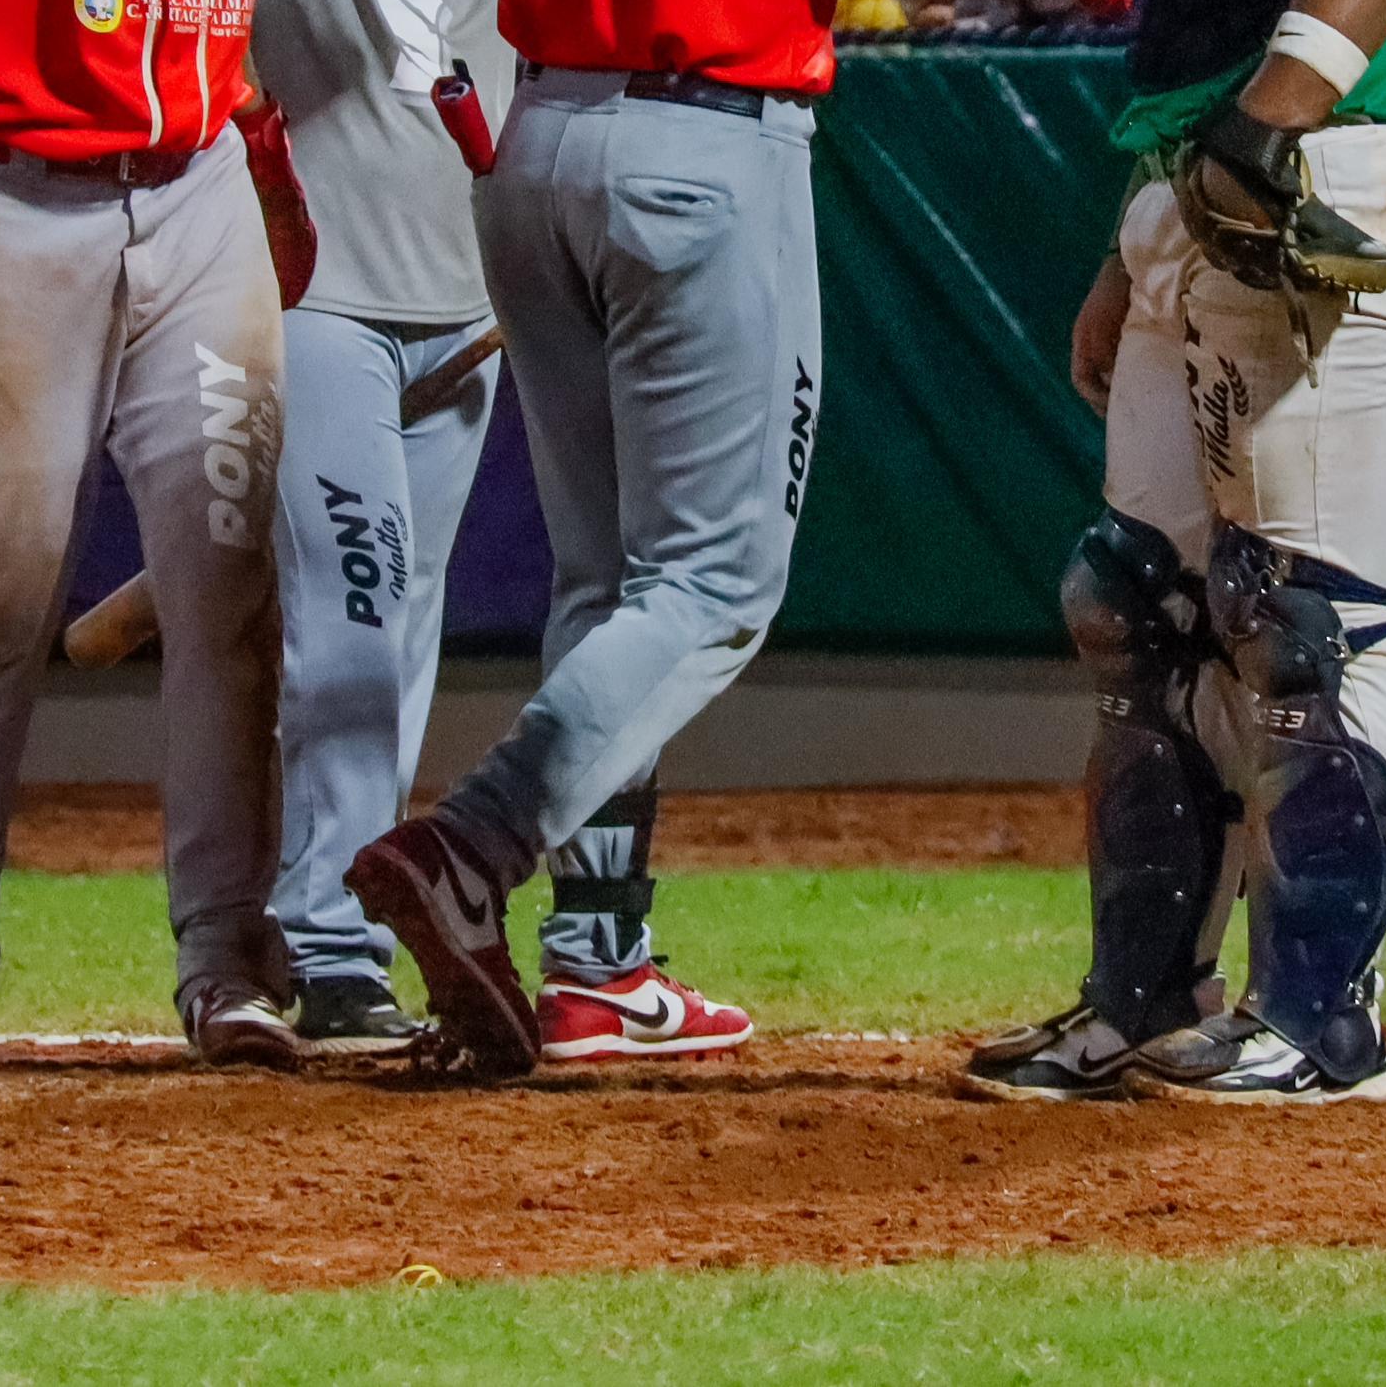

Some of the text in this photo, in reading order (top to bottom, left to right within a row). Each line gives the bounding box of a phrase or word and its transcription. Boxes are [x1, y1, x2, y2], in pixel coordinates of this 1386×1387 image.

[194, 340, 261, 551] PONY
[784, 354, 814, 522] PONY
[315, 472, 383, 629] PONY
[374, 515, 410, 601] Malta
